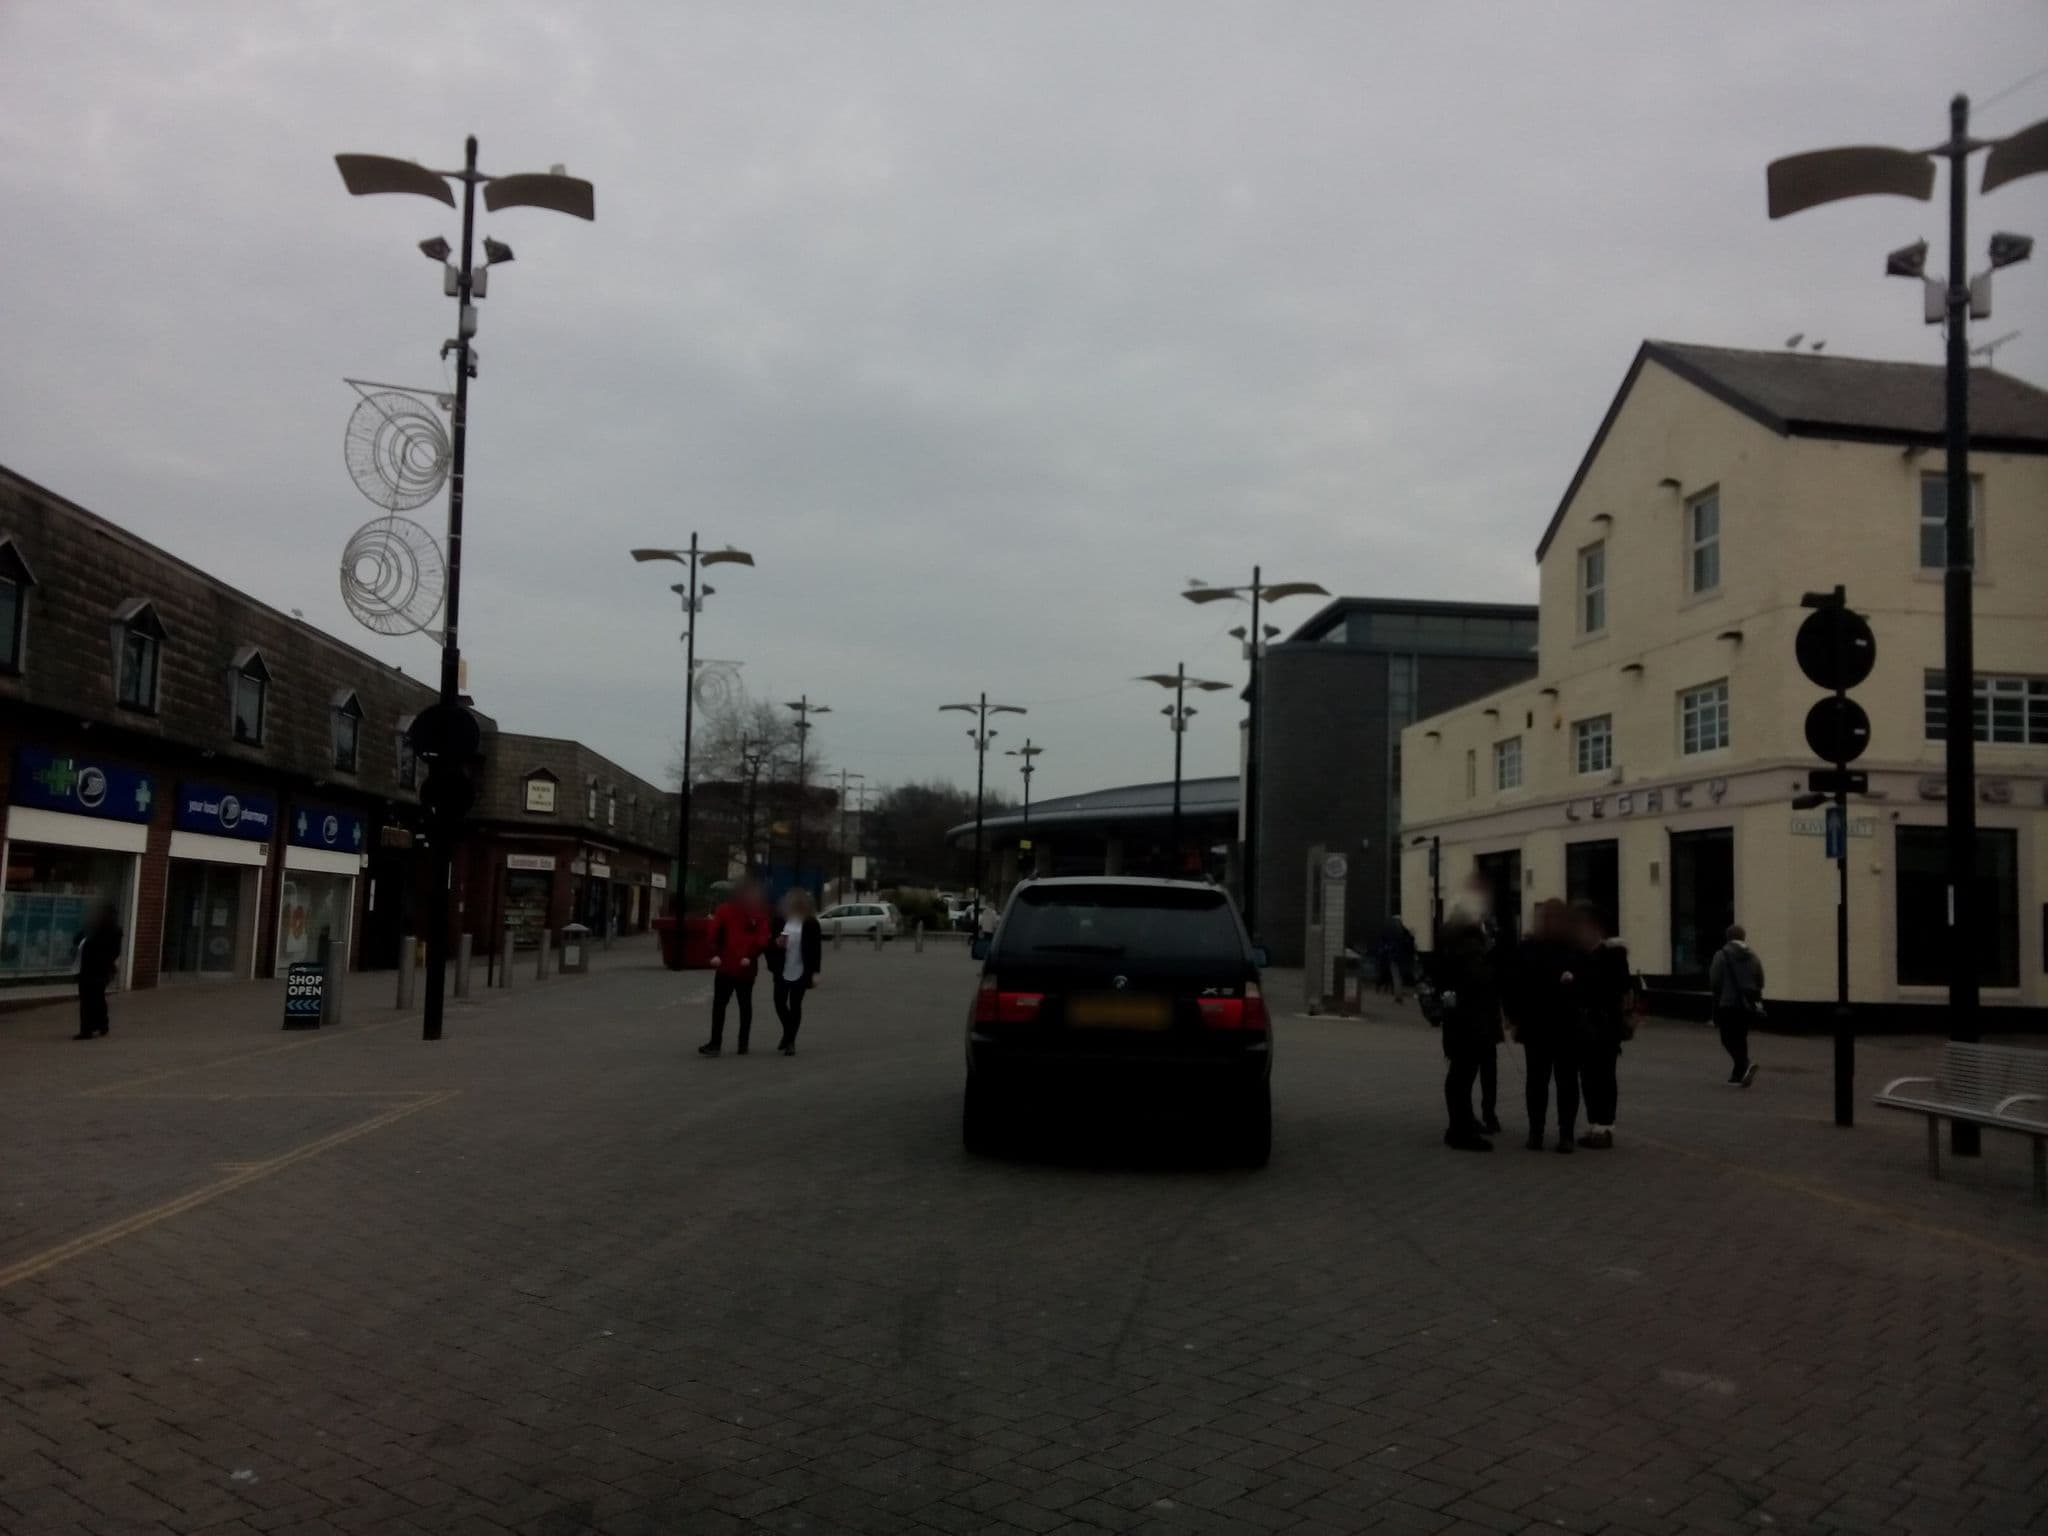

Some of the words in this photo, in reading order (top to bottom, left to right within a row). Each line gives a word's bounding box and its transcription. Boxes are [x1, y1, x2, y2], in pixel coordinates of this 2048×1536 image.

[1566, 777, 1728, 821] LEGACY
[288, 975, 323, 985] SHOP
[288, 986, 322, 996] OPEN
